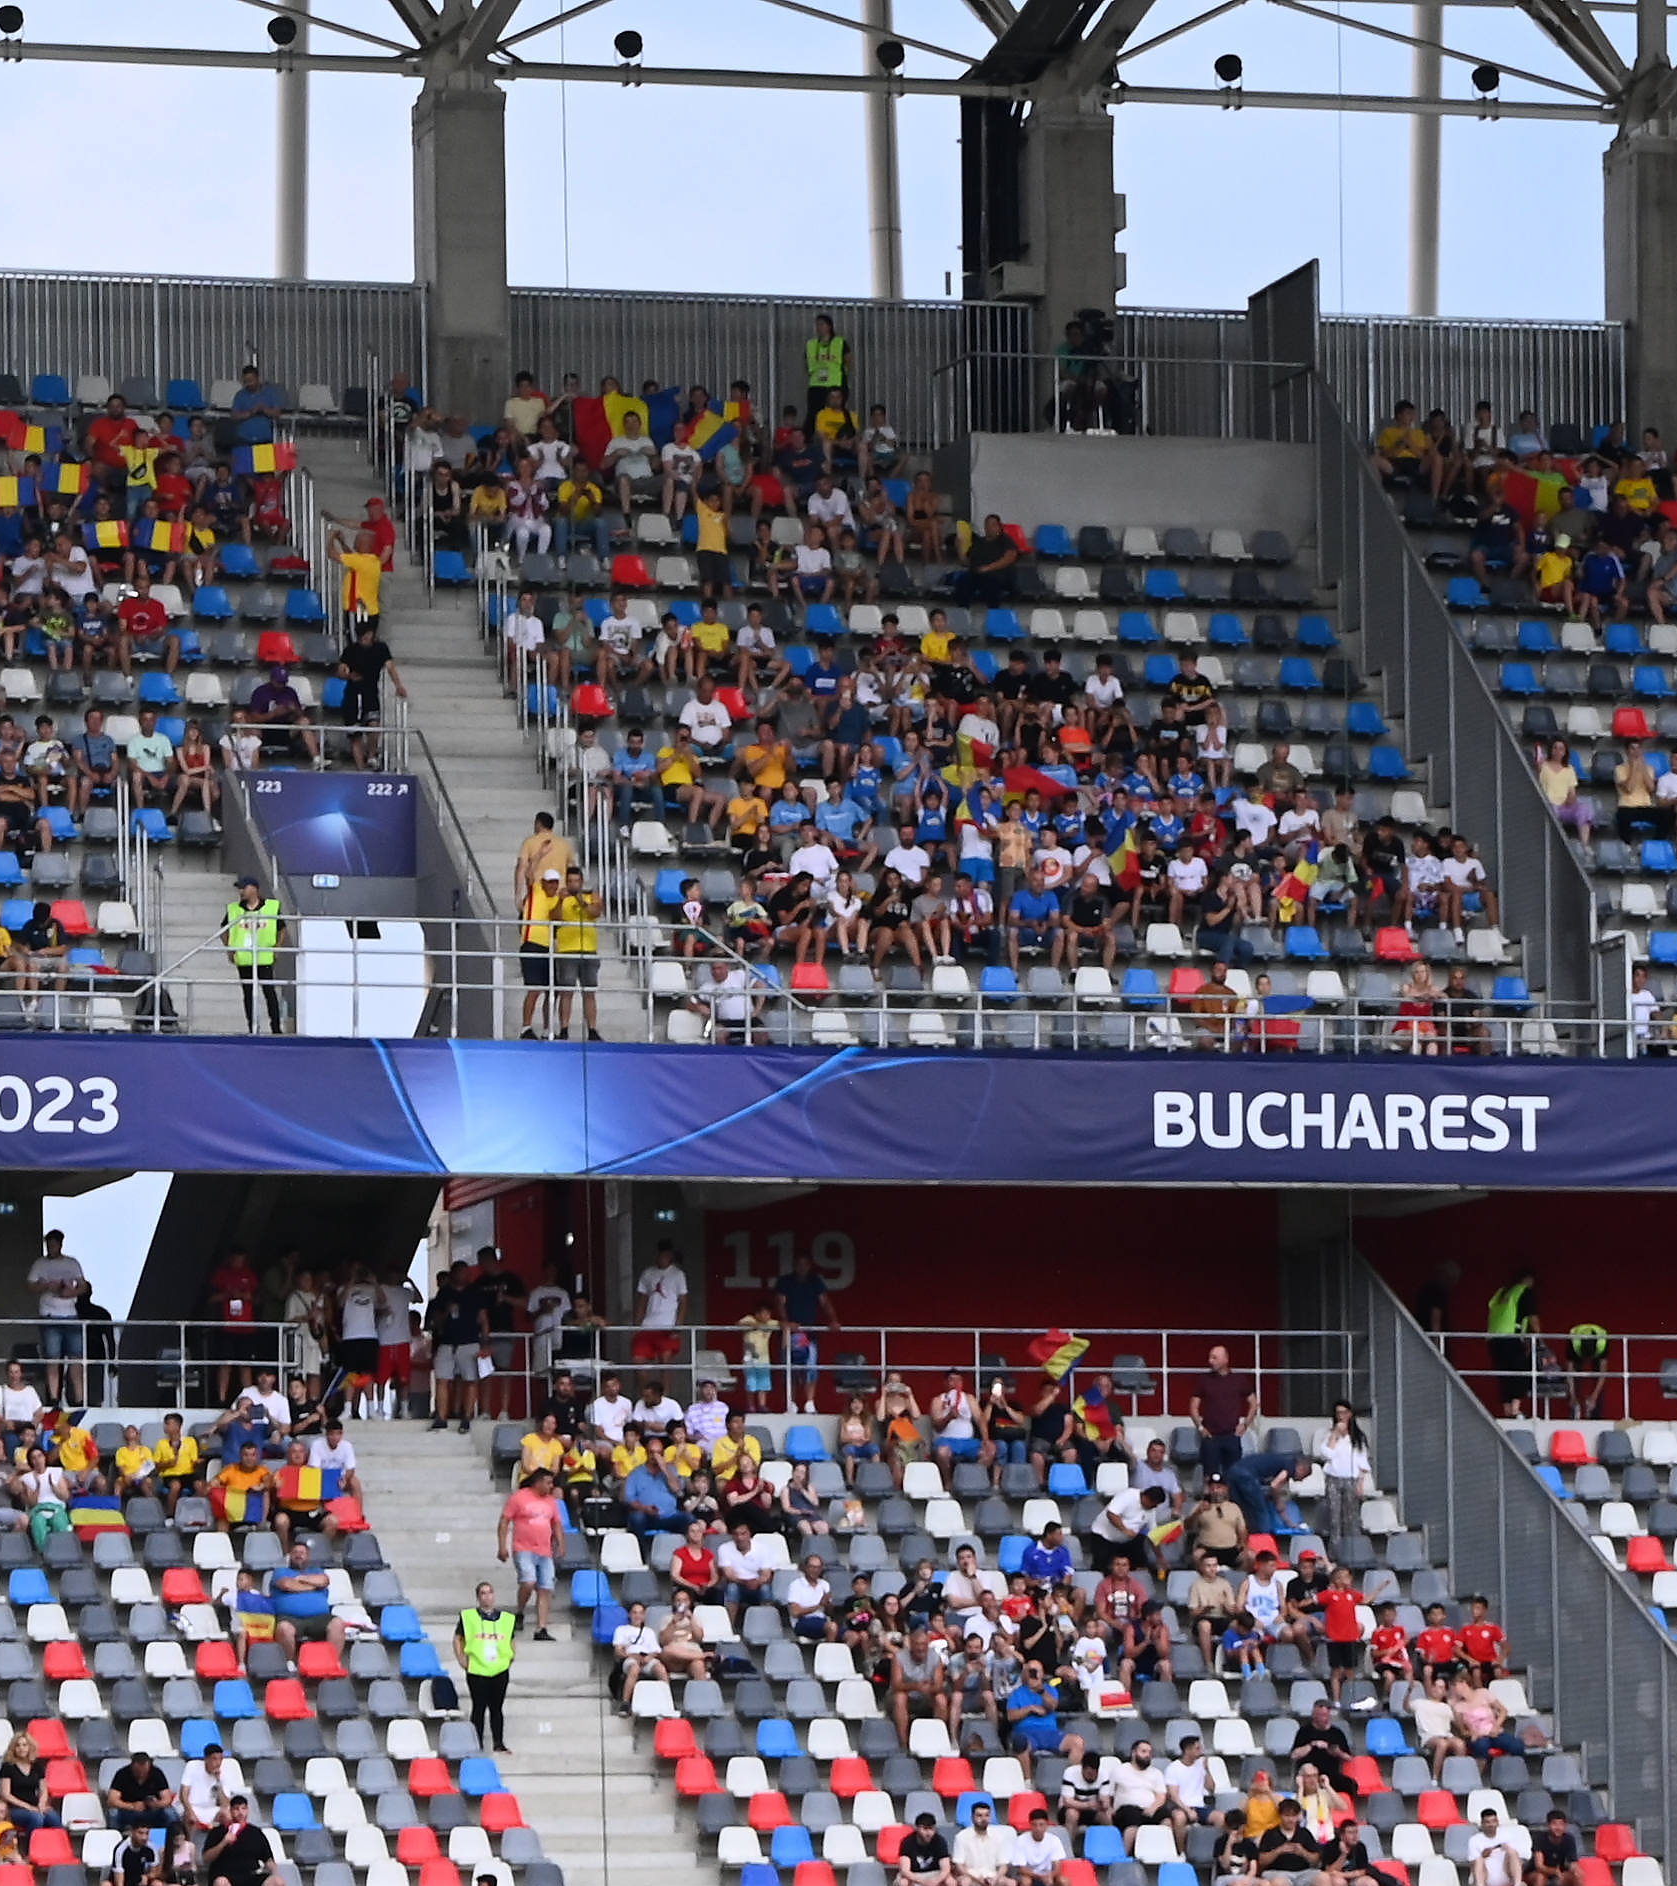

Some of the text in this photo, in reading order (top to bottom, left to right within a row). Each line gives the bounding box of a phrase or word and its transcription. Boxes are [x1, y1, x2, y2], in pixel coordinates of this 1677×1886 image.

[256, 780, 282, 793] 223
[367, 783, 393, 796] 222
[1153, 1091, 1550, 1152] BUCHAREST
[724, 1230, 856, 1291] 119
